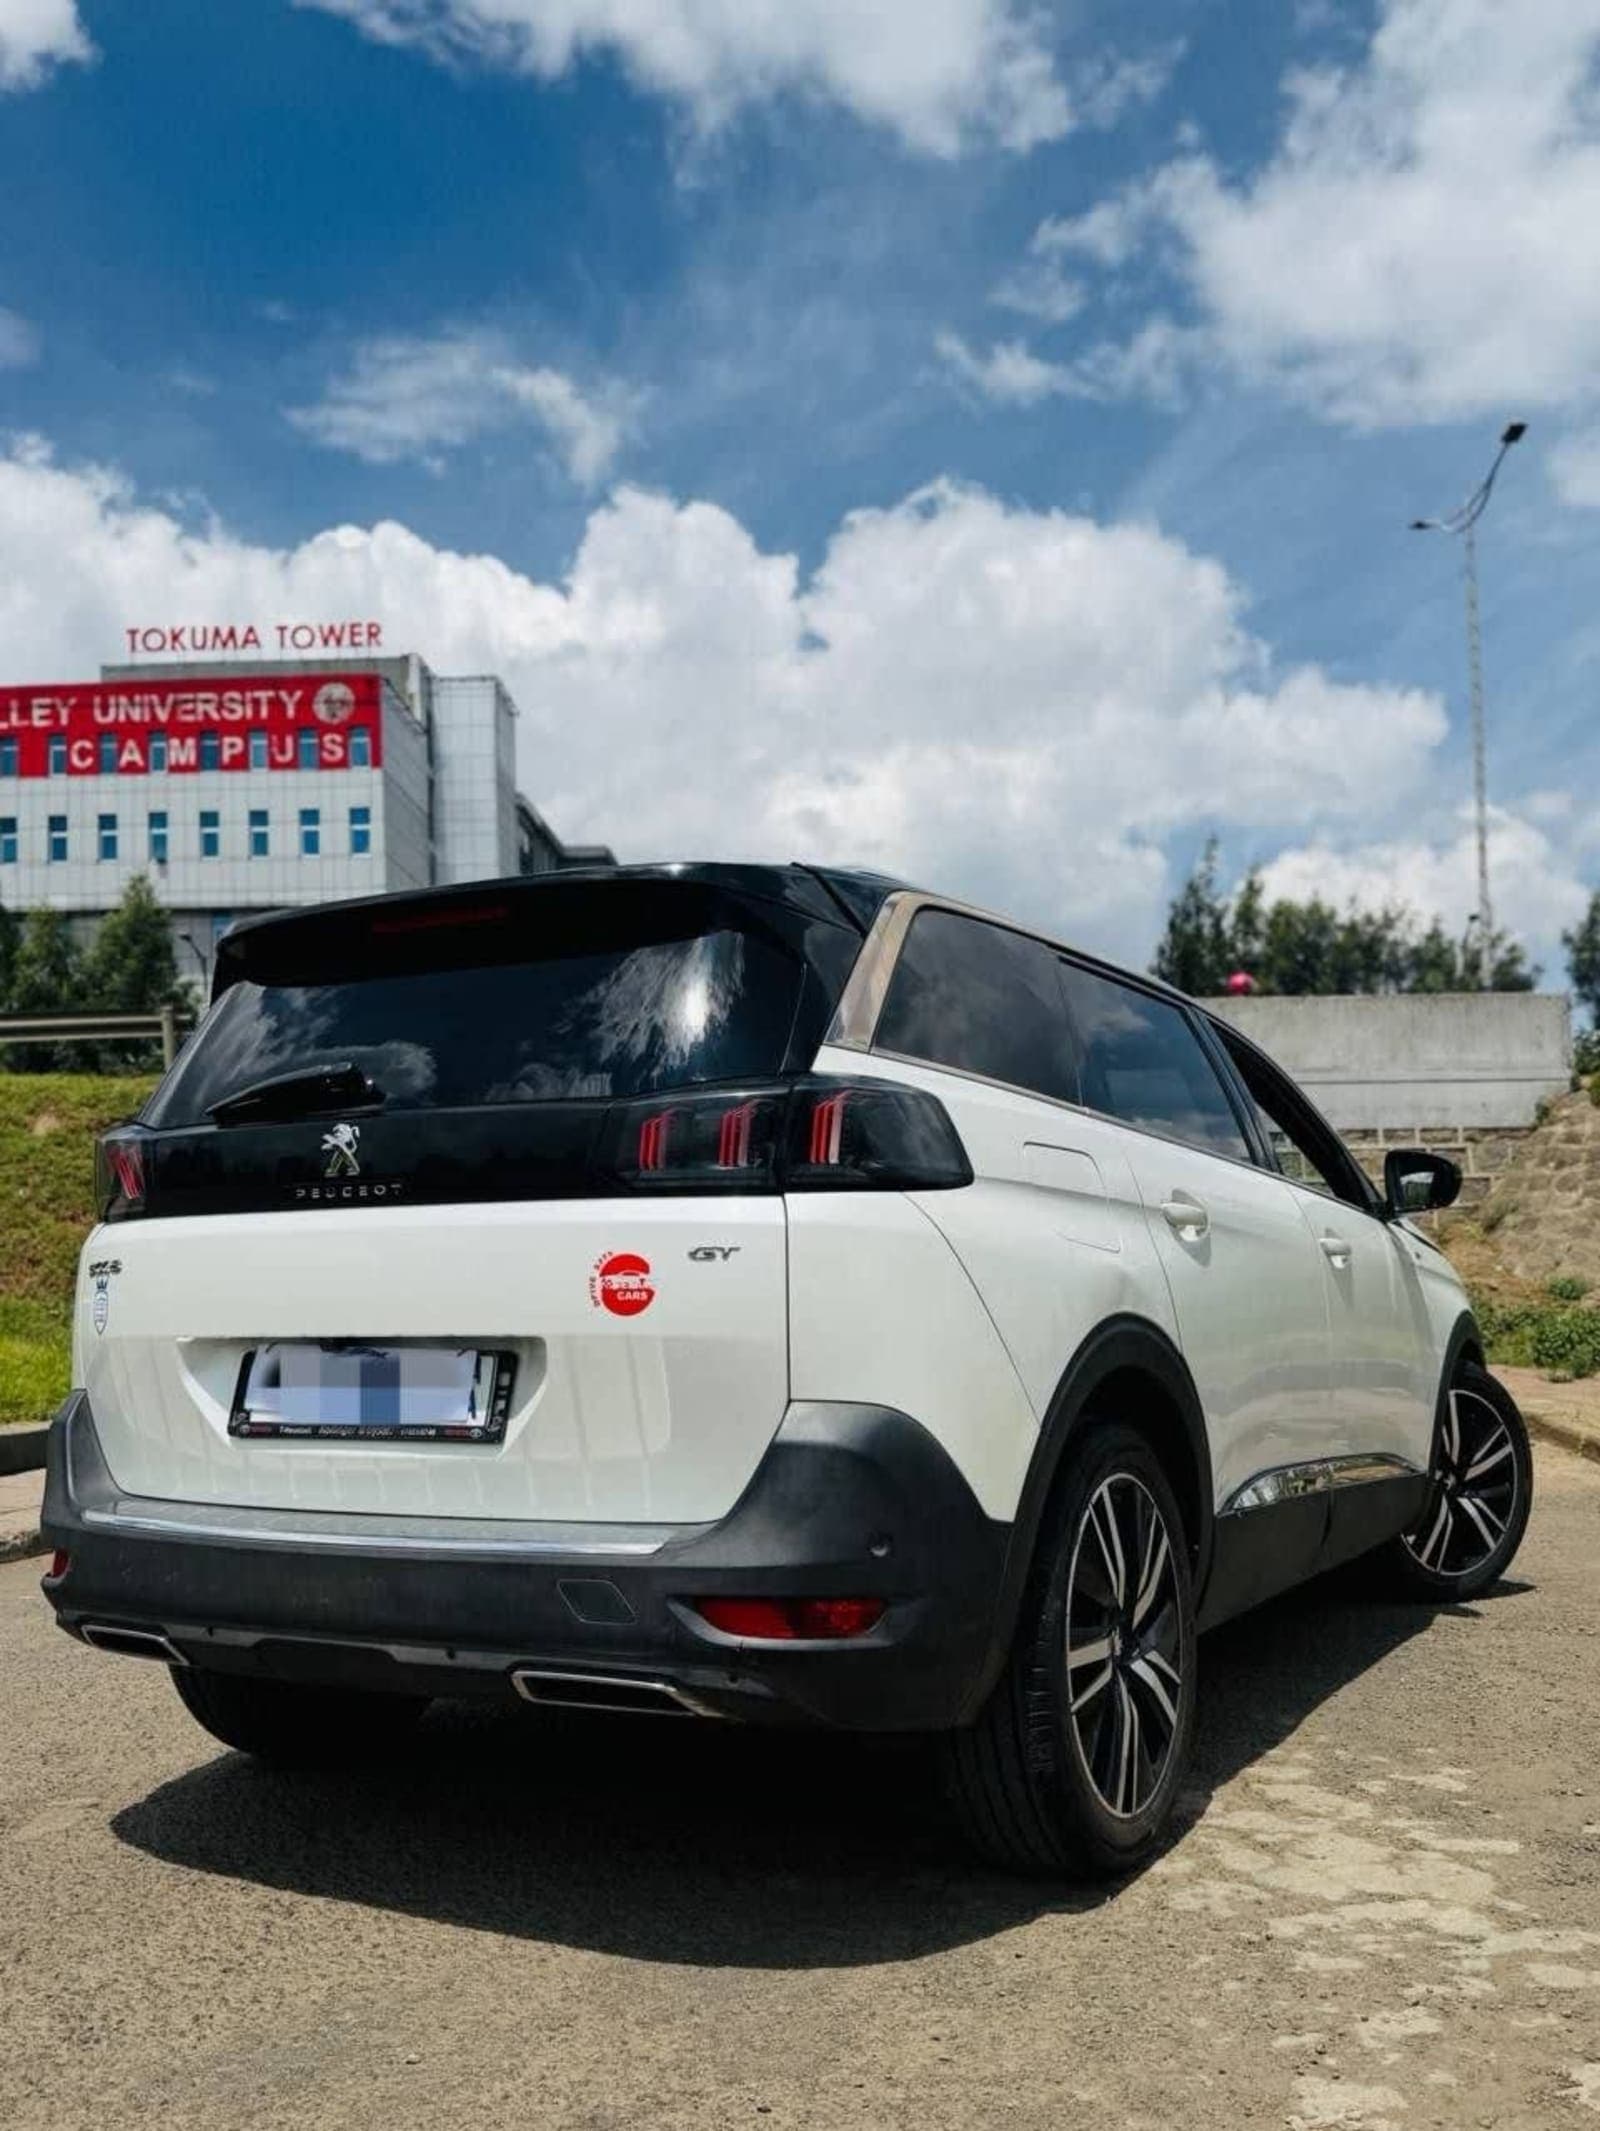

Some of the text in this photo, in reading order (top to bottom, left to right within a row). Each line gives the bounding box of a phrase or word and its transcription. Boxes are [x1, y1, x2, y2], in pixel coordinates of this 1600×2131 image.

[126, 622, 383, 653] TOKUMA TOWER
[0, 688, 303, 730] LEY UNIVERSITY
[70, 732, 345, 769] CAMPUS
[616, 1290, 648, 1301] CARS
